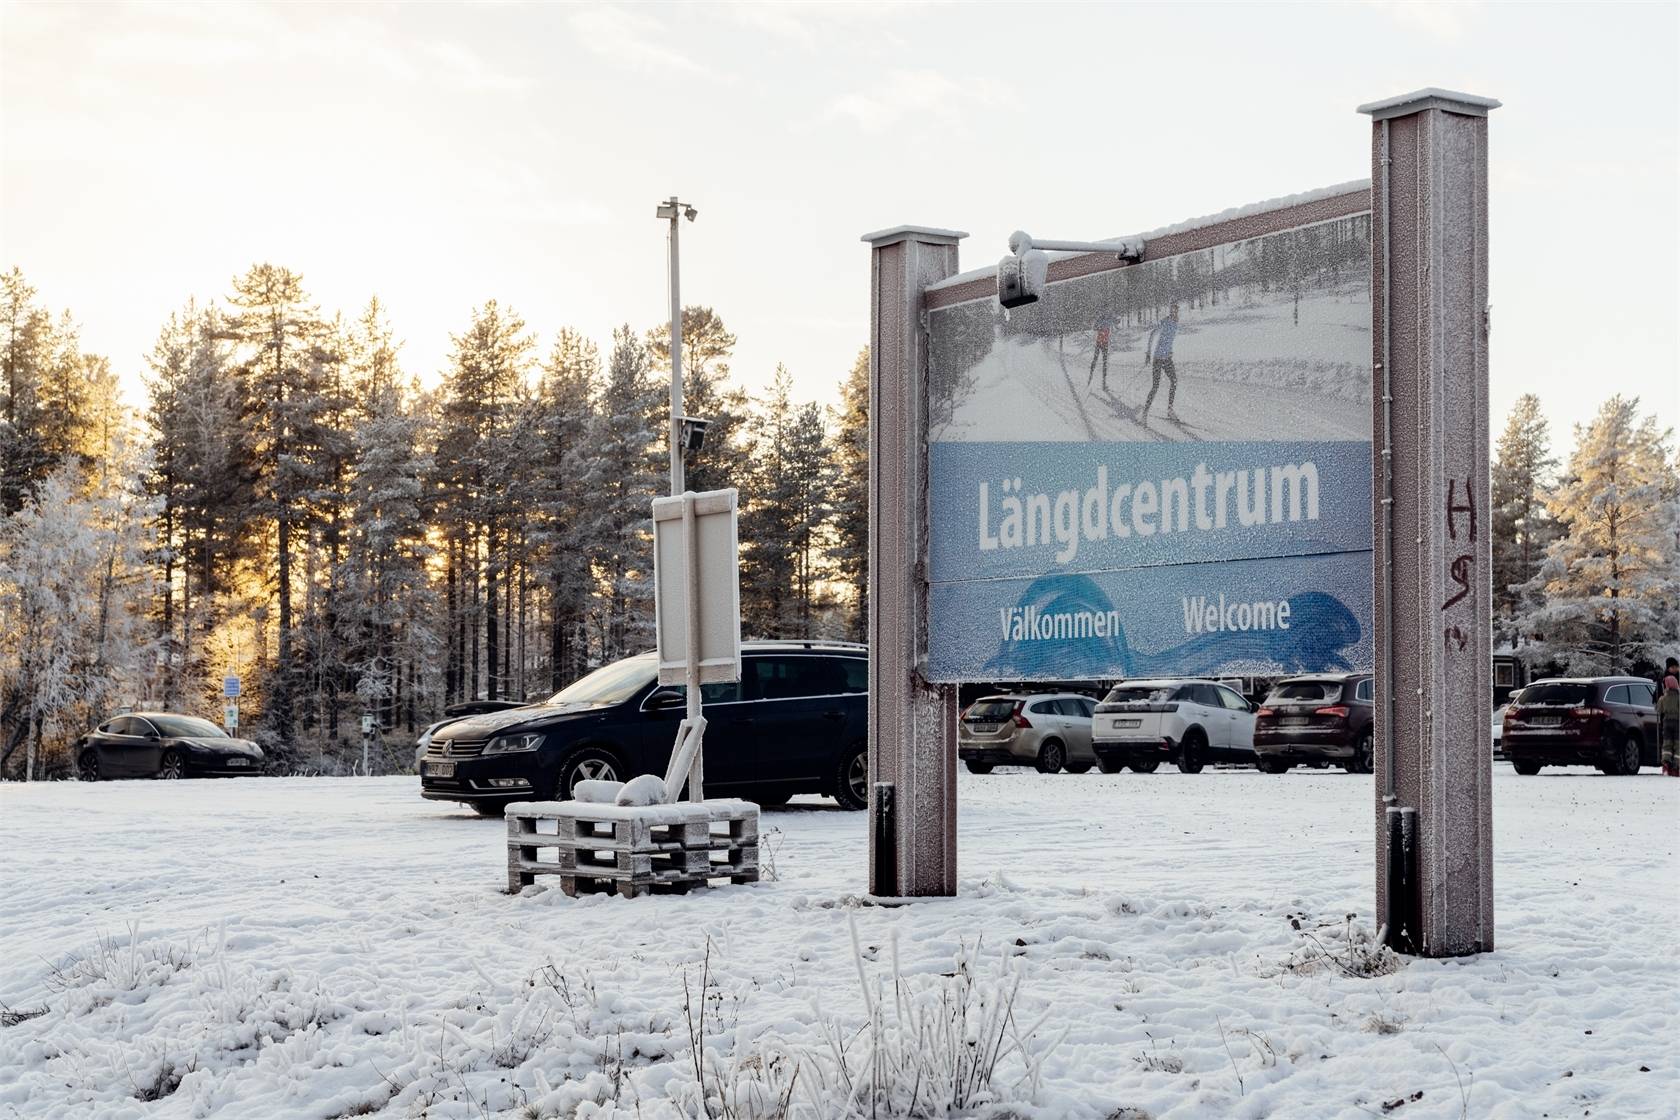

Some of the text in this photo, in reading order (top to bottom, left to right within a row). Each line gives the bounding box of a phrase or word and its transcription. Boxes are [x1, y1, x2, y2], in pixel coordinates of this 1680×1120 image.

[979, 461, 1319, 563] Längdcentrum
[1000, 596, 1290, 640] Välkommen Welcome
